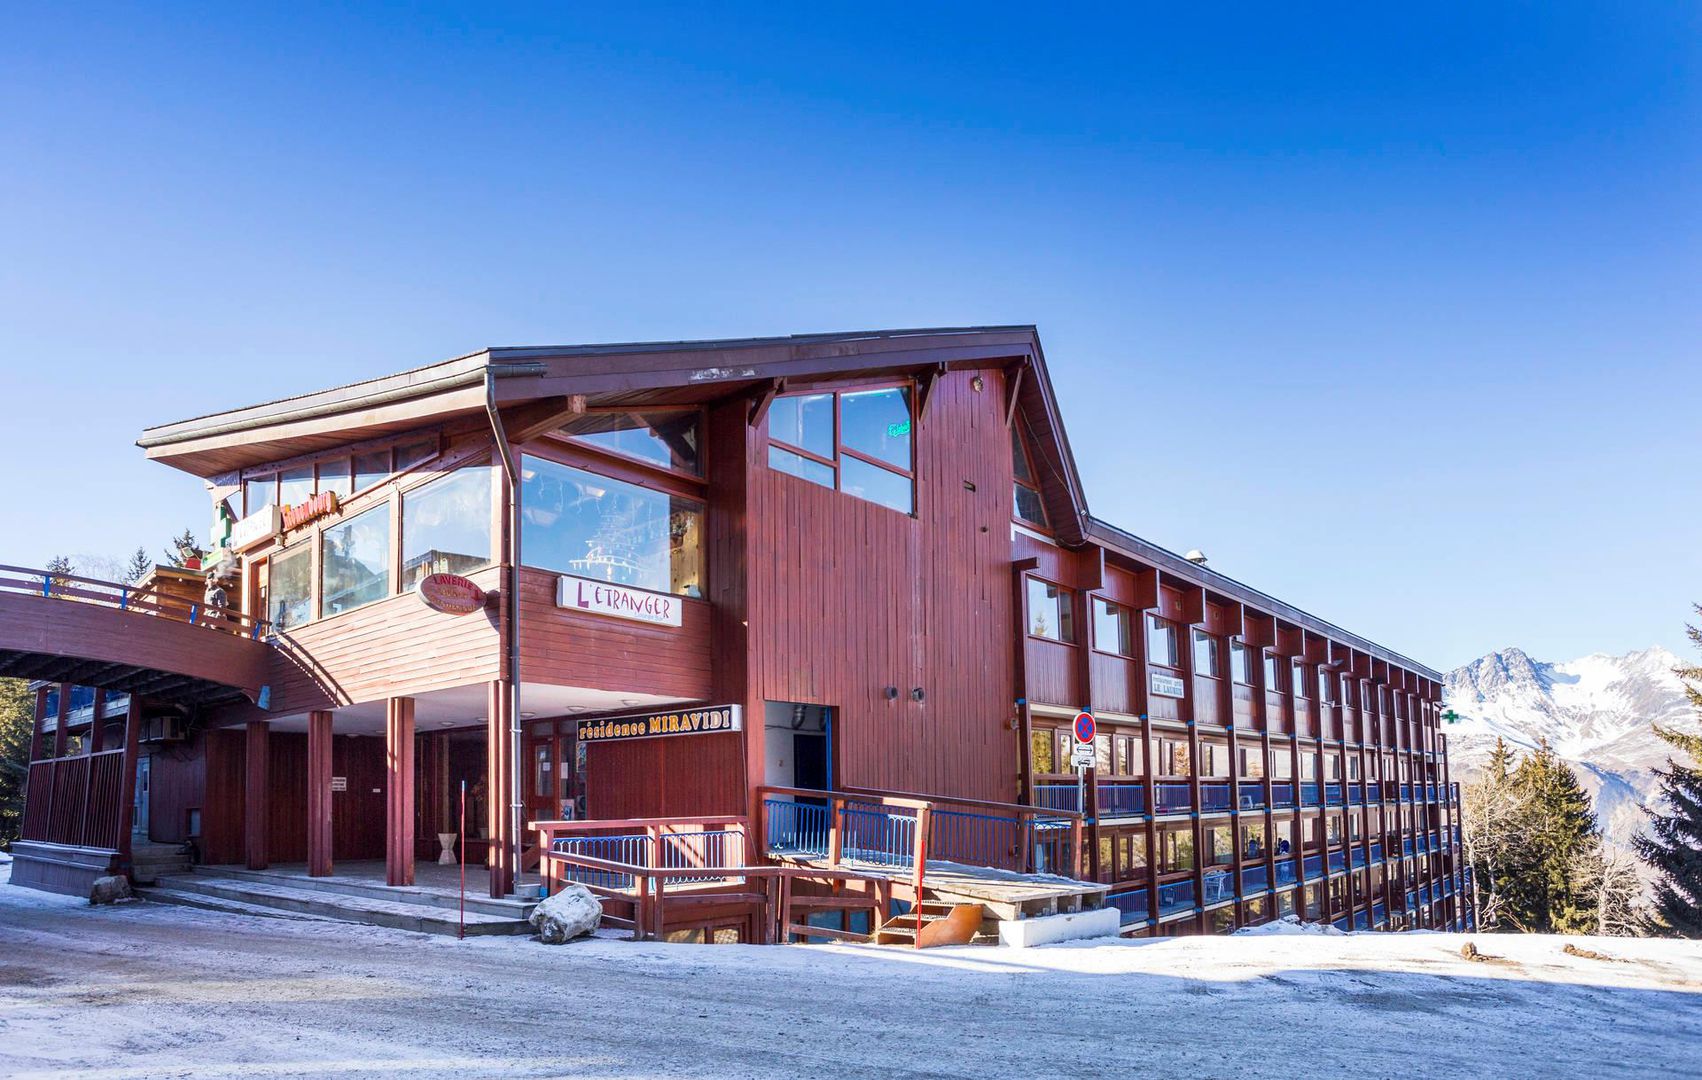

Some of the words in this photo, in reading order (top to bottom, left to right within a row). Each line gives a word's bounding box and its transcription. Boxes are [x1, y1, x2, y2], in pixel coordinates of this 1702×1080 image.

[433, 575, 474, 591] LAVERIE
[579, 720, 646, 740] résidence
[649, 709, 730, 734] MIRAVIDI
